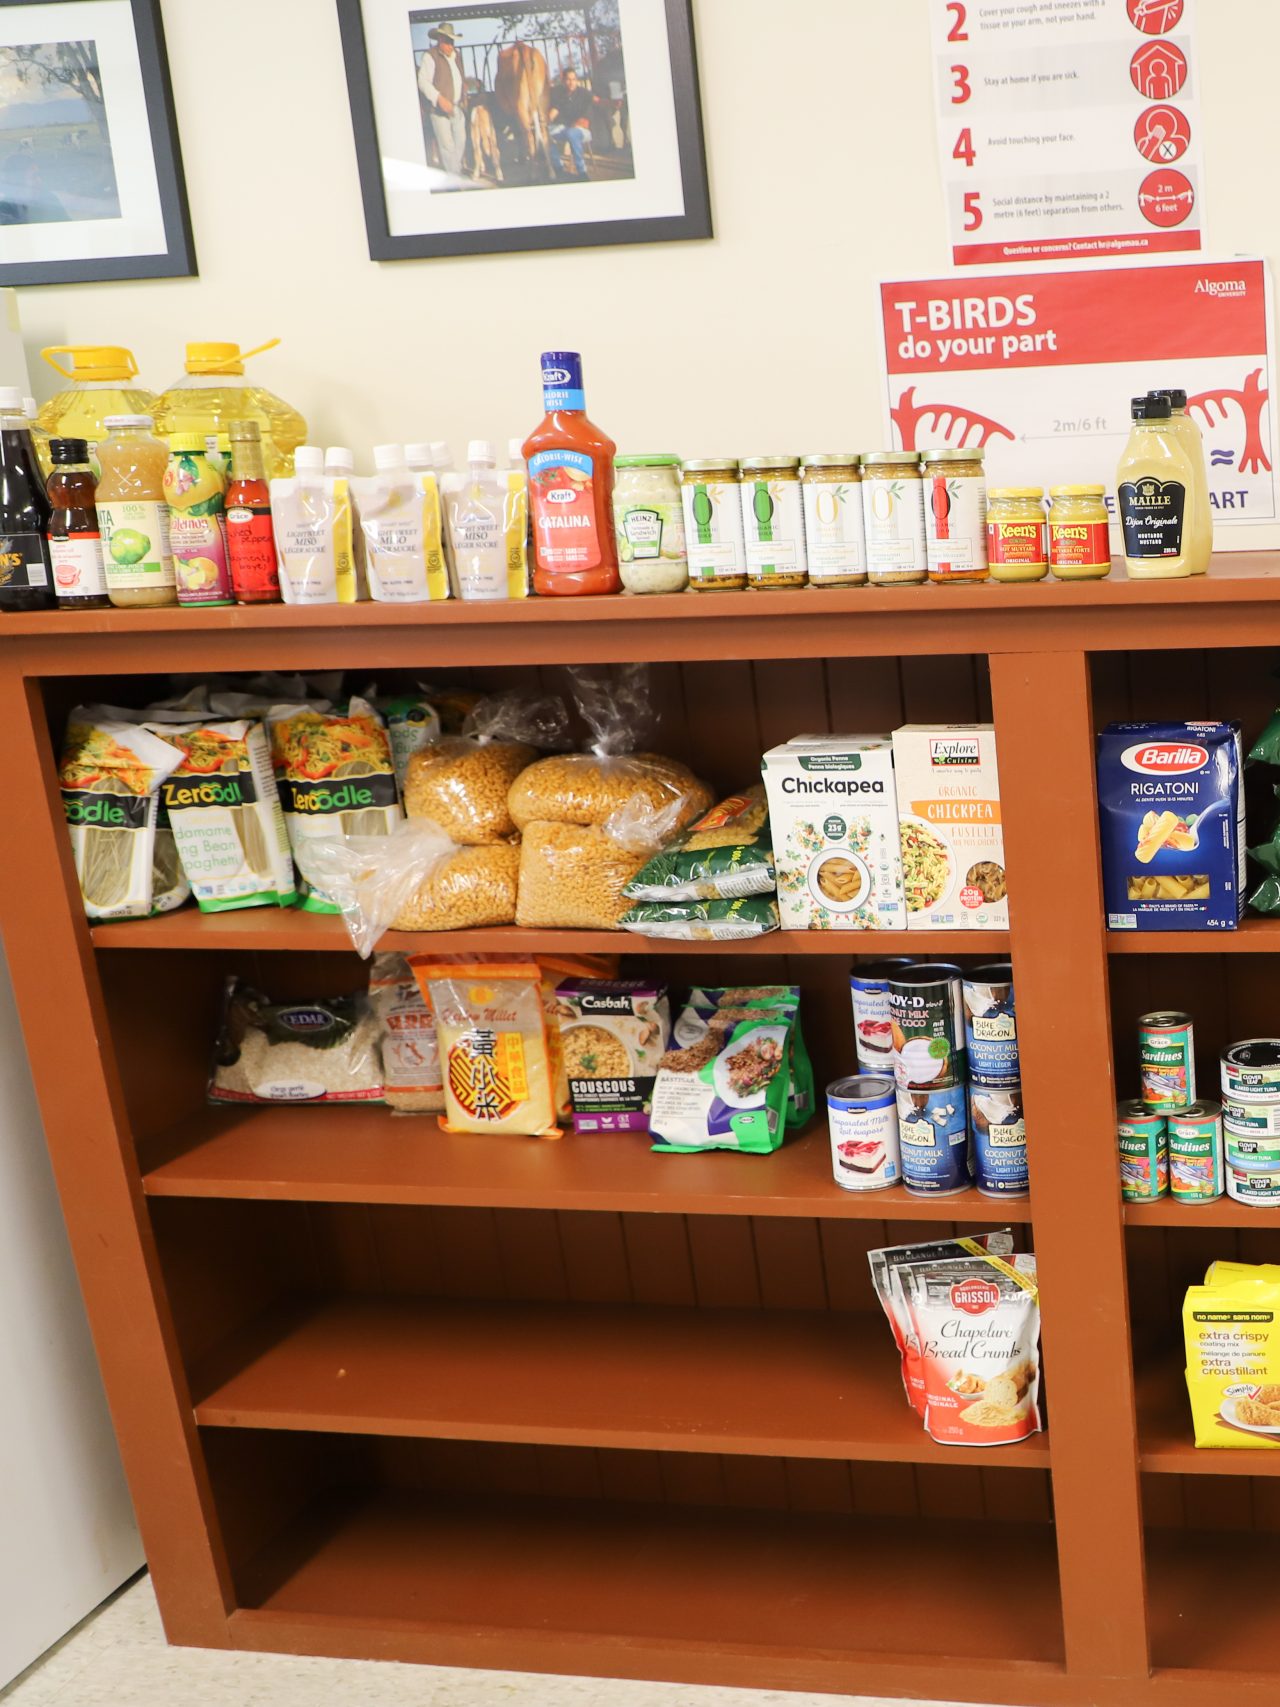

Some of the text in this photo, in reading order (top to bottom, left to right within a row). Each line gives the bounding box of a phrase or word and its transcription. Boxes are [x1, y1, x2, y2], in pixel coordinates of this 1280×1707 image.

[946, 2, 969, 42] 2
[950, 64, 972, 104] 3
[984, 77, 1000, 87] Stay
[1000, 77, 1008, 85] at
[1009, 76, 1029, 84] home
[1038, 74, 1050, 83] you
[1064, 71, 1079, 80] sick.
[987, 133, 1076, 146] Avoid touching your face.
[953, 128, 976, 167] 4
[1157, 184, 1165, 193] 2
[992, 197, 1013, 207] Social
[1014, 195, 1043, 205] distance
[1044, 194, 1053, 204] by
[1054, 191, 1098, 202] maintaining
[1105, 191, 1110, 199] 2
[963, 192, 984, 231] 5
[993, 210, 1015, 220] metre
[1024, 207, 1042, 218] feet)
[1043, 205, 1080, 217] separation
[1081, 204, 1099, 213] from
[1099, 202, 1124, 213] others.
[1003, 238, 1149, 256] Question or concerns? Contact hr@algomau.ca
[1193, 278, 1245, 299] Algoma
[894, 294, 1037, 333] T-BIRDS
[898, 329, 1057, 363] do your part
[1128, 495, 1172, 506] MAILLE
[538, 516, 592, 529] CATALINA
[630, 515, 652, 523] HEINZ
[463, 531, 488, 542] MISO
[998, 523, 1037, 539] Keen's
[1137, 532, 1164, 540] MOUTARDE
[1005, 557, 1032, 565] ORIGINAL
[933, 741, 978, 757] Explore
[947, 757, 979, 765] Cuisine
[1141, 747, 1202, 766] Barilla
[808, 764, 857, 773] Penne biologiques
[781, 776, 885, 797] Chickapea
[938, 785, 978, 797] ORGANIC
[1130, 782, 1200, 796] RIGATONI
[290, 783, 374, 811] Zeroodle
[927, 803, 994, 819] CHICKPEA
[175, 824, 234, 841] damame
[963, 889, 980, 898] 20g
[581, 996, 632, 1010] Casbah
[902, 1018, 927, 1028] COCO
[975, 1020, 994, 1030] BLUE
[975, 1027, 1010, 1039] DRAGON
[1241, 1073, 1263, 1081] CLOVER
[571, 1079, 637, 1096] COUSCOUS
[984, 1149, 1022, 1158] COCONUT
[953, 1289, 997, 1304] GRISSOL
[1198, 1330, 1270, 1344] extra crispy
[1200, 1350, 1228, 1360] mélange
[1237, 1350, 1267, 1359] panure
[1200, 1357, 1232, 1367] extra
[1201, 1364, 1269, 1377] croustillant
